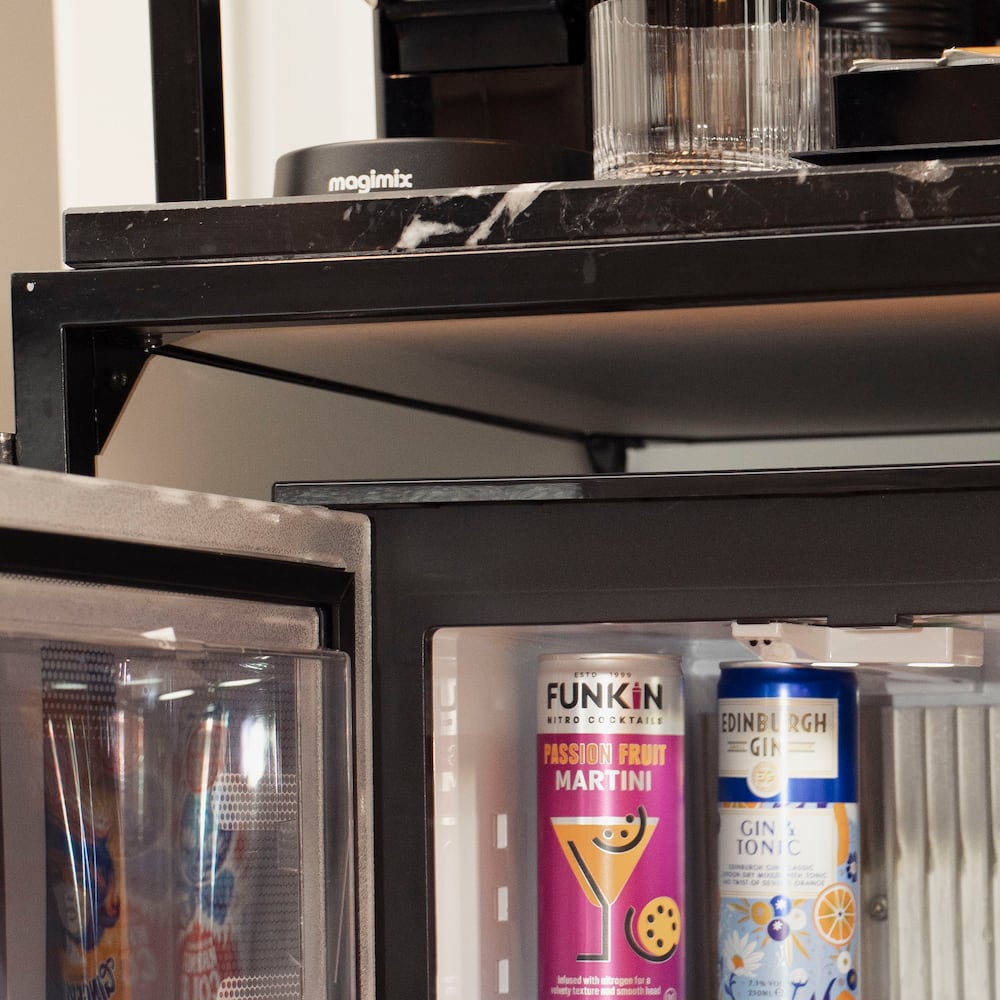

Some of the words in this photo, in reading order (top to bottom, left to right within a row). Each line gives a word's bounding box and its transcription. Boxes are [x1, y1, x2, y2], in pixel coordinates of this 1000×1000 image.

[328, 168, 413, 194] magimix
[547, 716, 580, 725] NITRO
[588, 716, 664, 725] COCKTAILS
[543, 743, 613, 766] PASSION
[618, 743, 667, 766] FRUIT
[750, 737, 782, 757] GIN
[555, 770, 652, 792] MARTINI
[740, 820, 774, 836] GIN
[737, 839, 801, 856] TONIC
[583, 976, 600, 985] with
